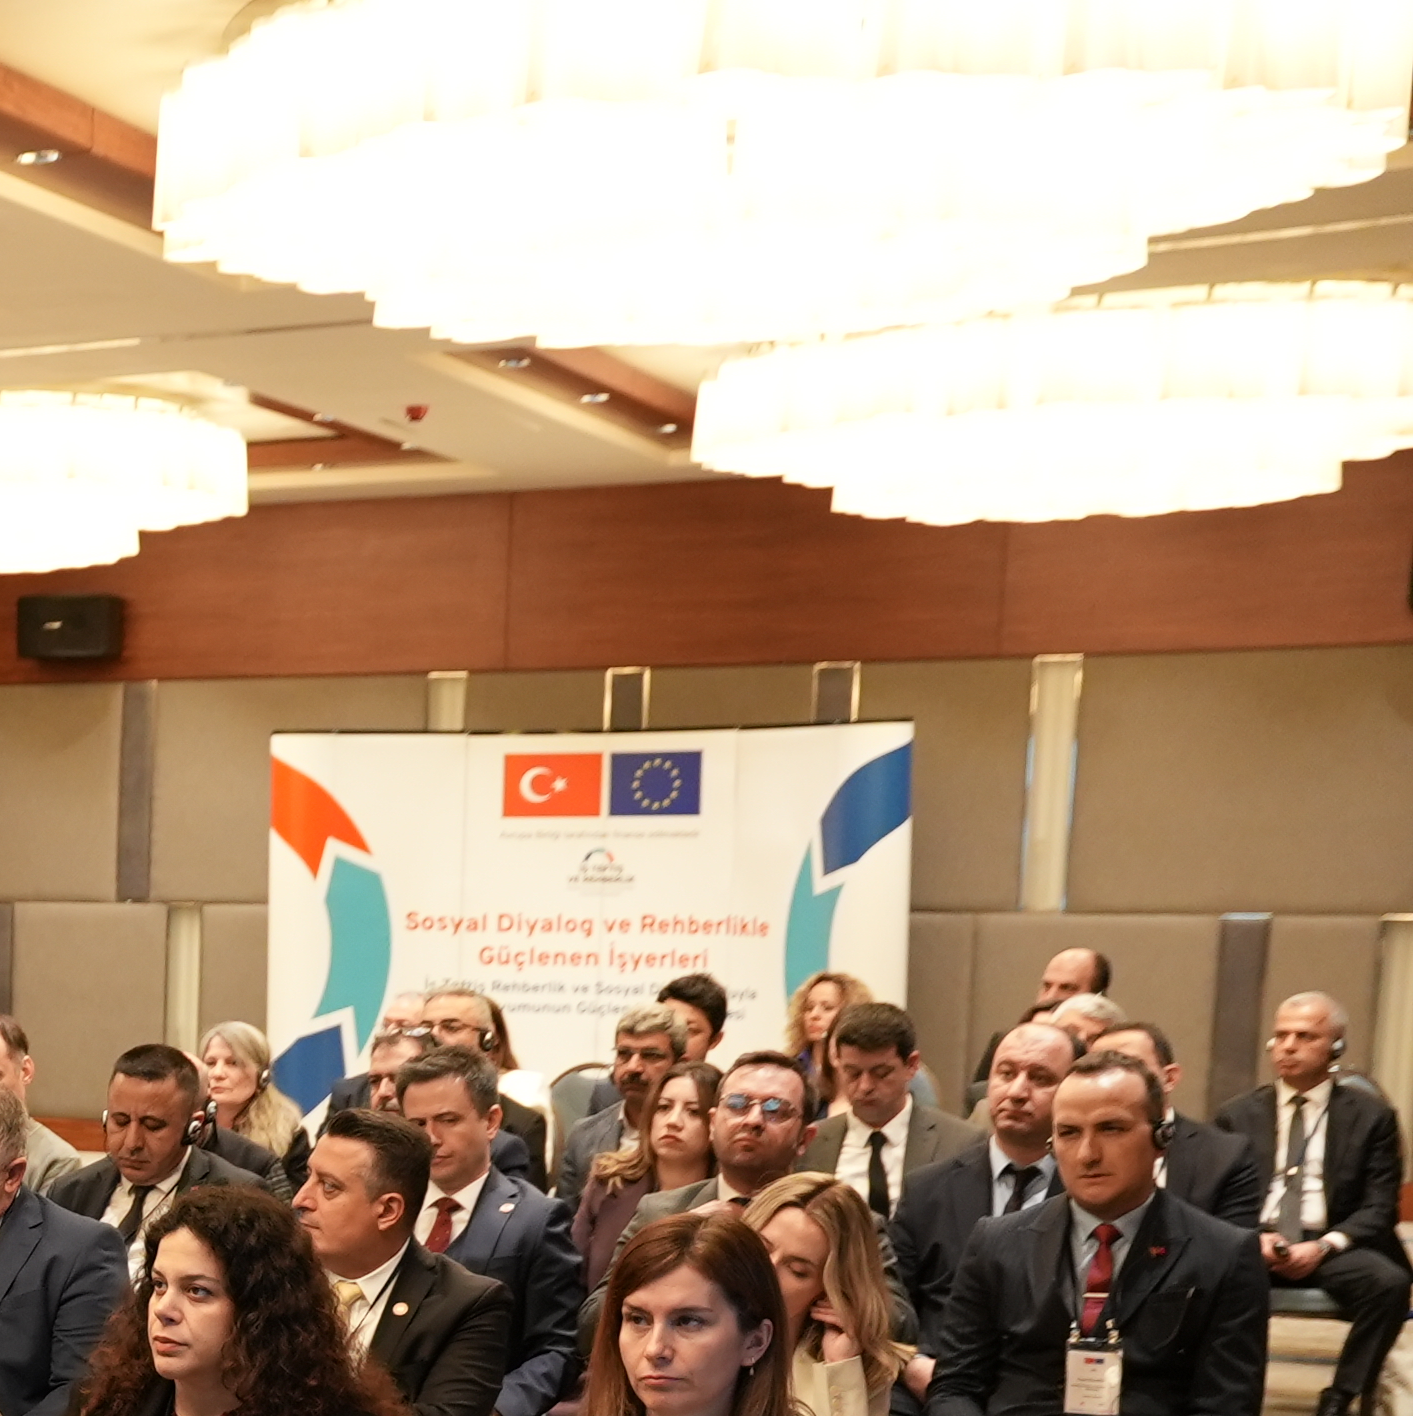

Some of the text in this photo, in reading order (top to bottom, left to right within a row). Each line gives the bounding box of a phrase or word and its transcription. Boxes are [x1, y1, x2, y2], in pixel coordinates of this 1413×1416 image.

[405, 910, 770, 938] Sosyal Diyalog ve Rehberlikle
[479, 941, 709, 974] Güçlenen İşyerleri
